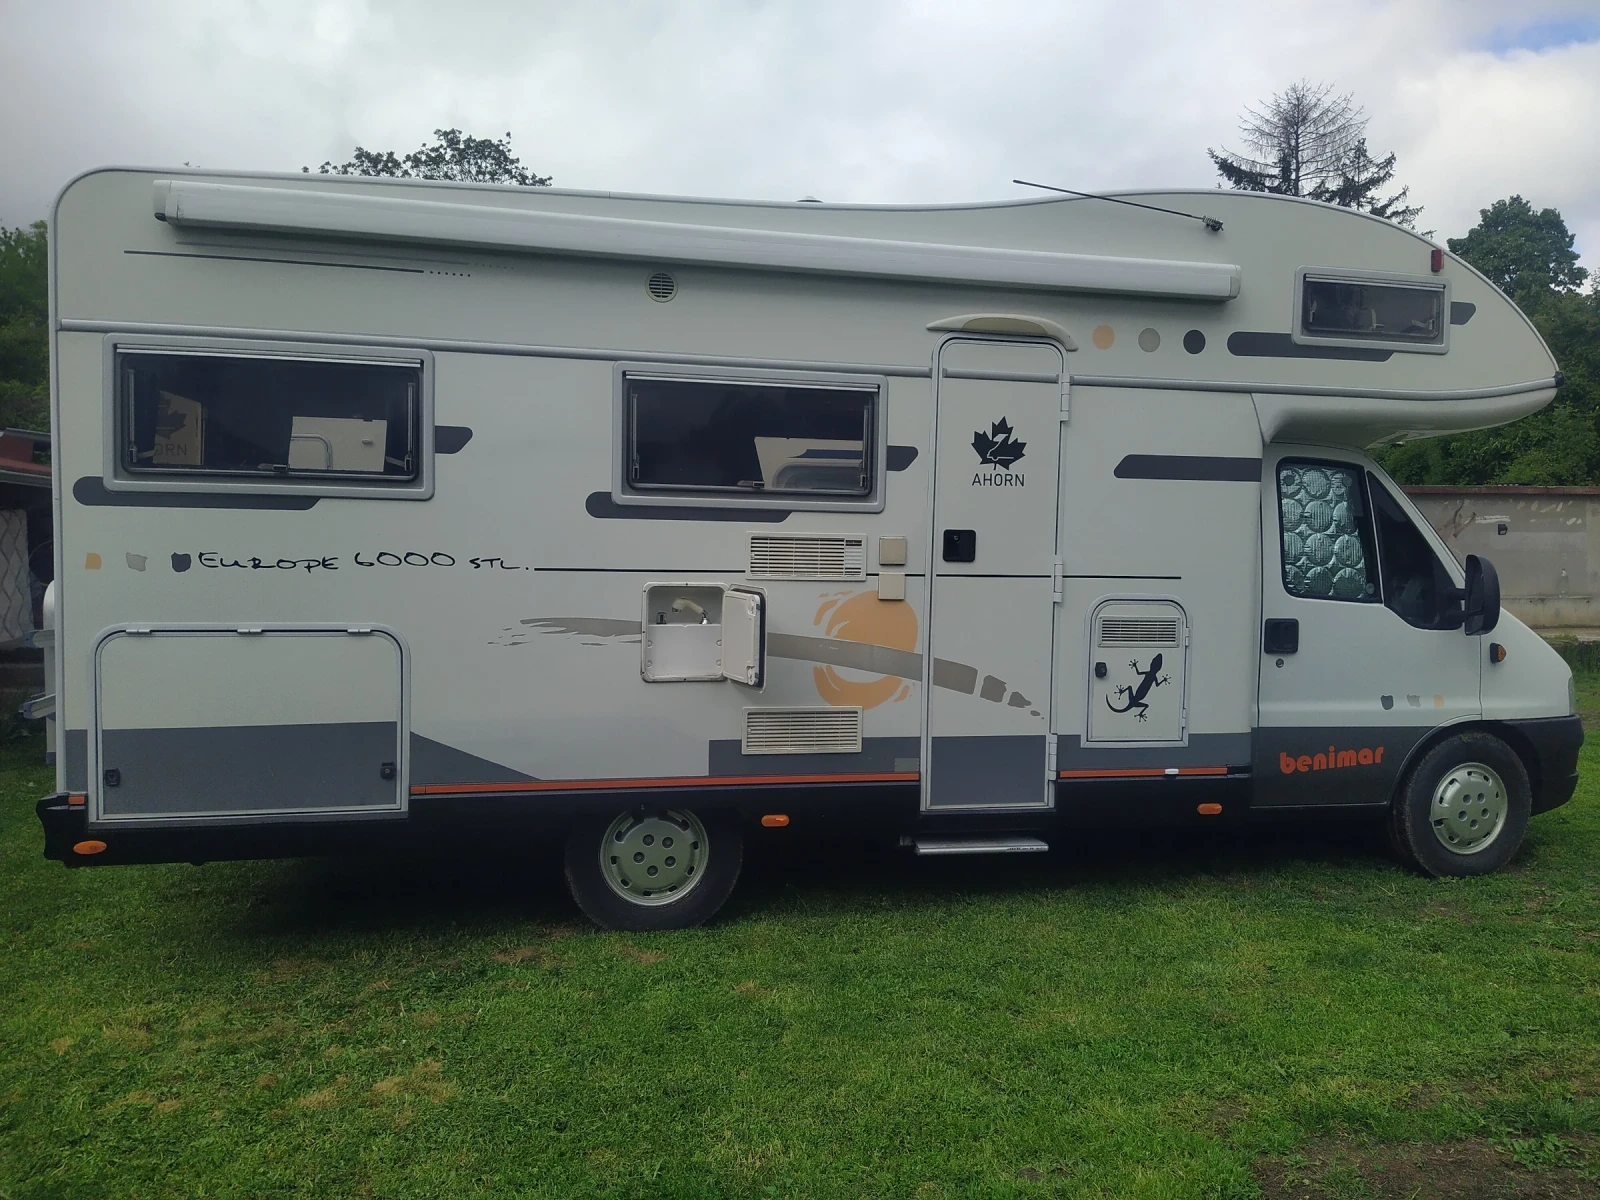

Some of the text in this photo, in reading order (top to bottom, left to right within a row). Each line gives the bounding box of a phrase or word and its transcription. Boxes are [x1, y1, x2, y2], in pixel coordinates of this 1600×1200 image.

[971, 472, 1025, 487] AHORN
[354, 551, 456, 567] 6000
[1279, 745, 1384, 774] benimar
